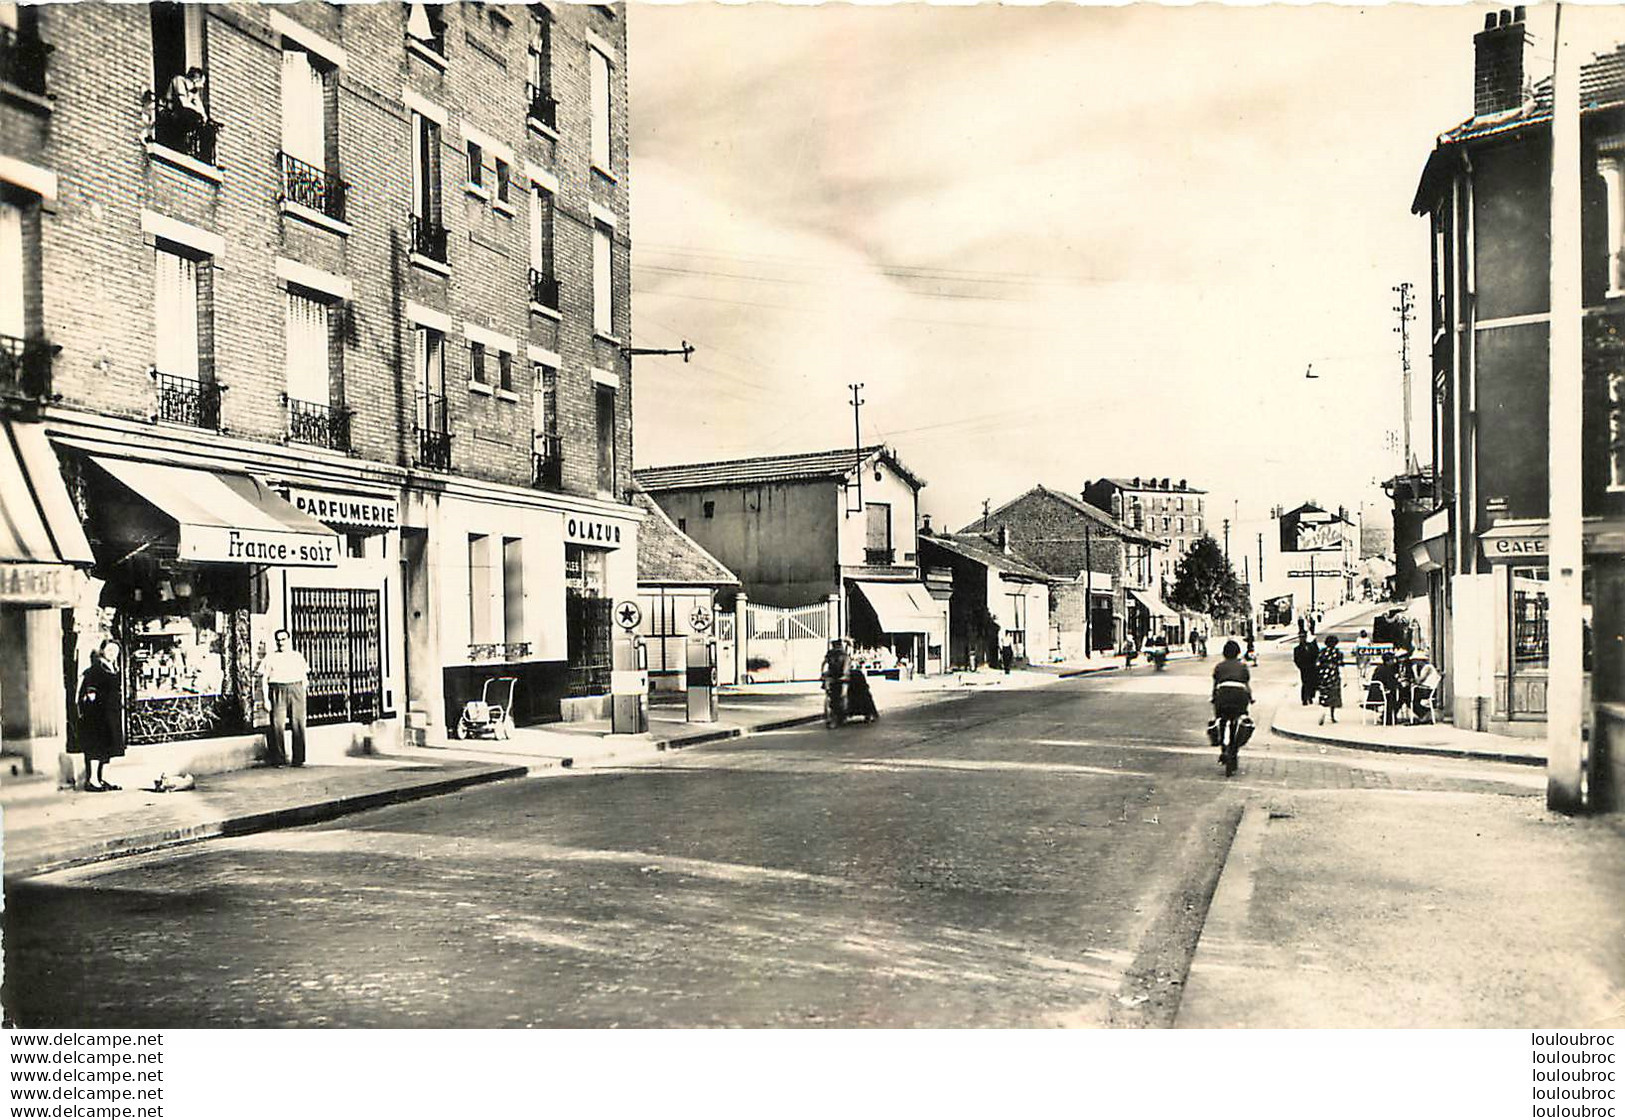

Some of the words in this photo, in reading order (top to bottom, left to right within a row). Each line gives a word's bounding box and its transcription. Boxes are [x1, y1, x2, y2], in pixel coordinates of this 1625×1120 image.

[297, 497, 395, 523] PARFUMERIE
[568, 519, 620, 543] OLAZUR
[1496, 540, 1545, 553] CAFE
